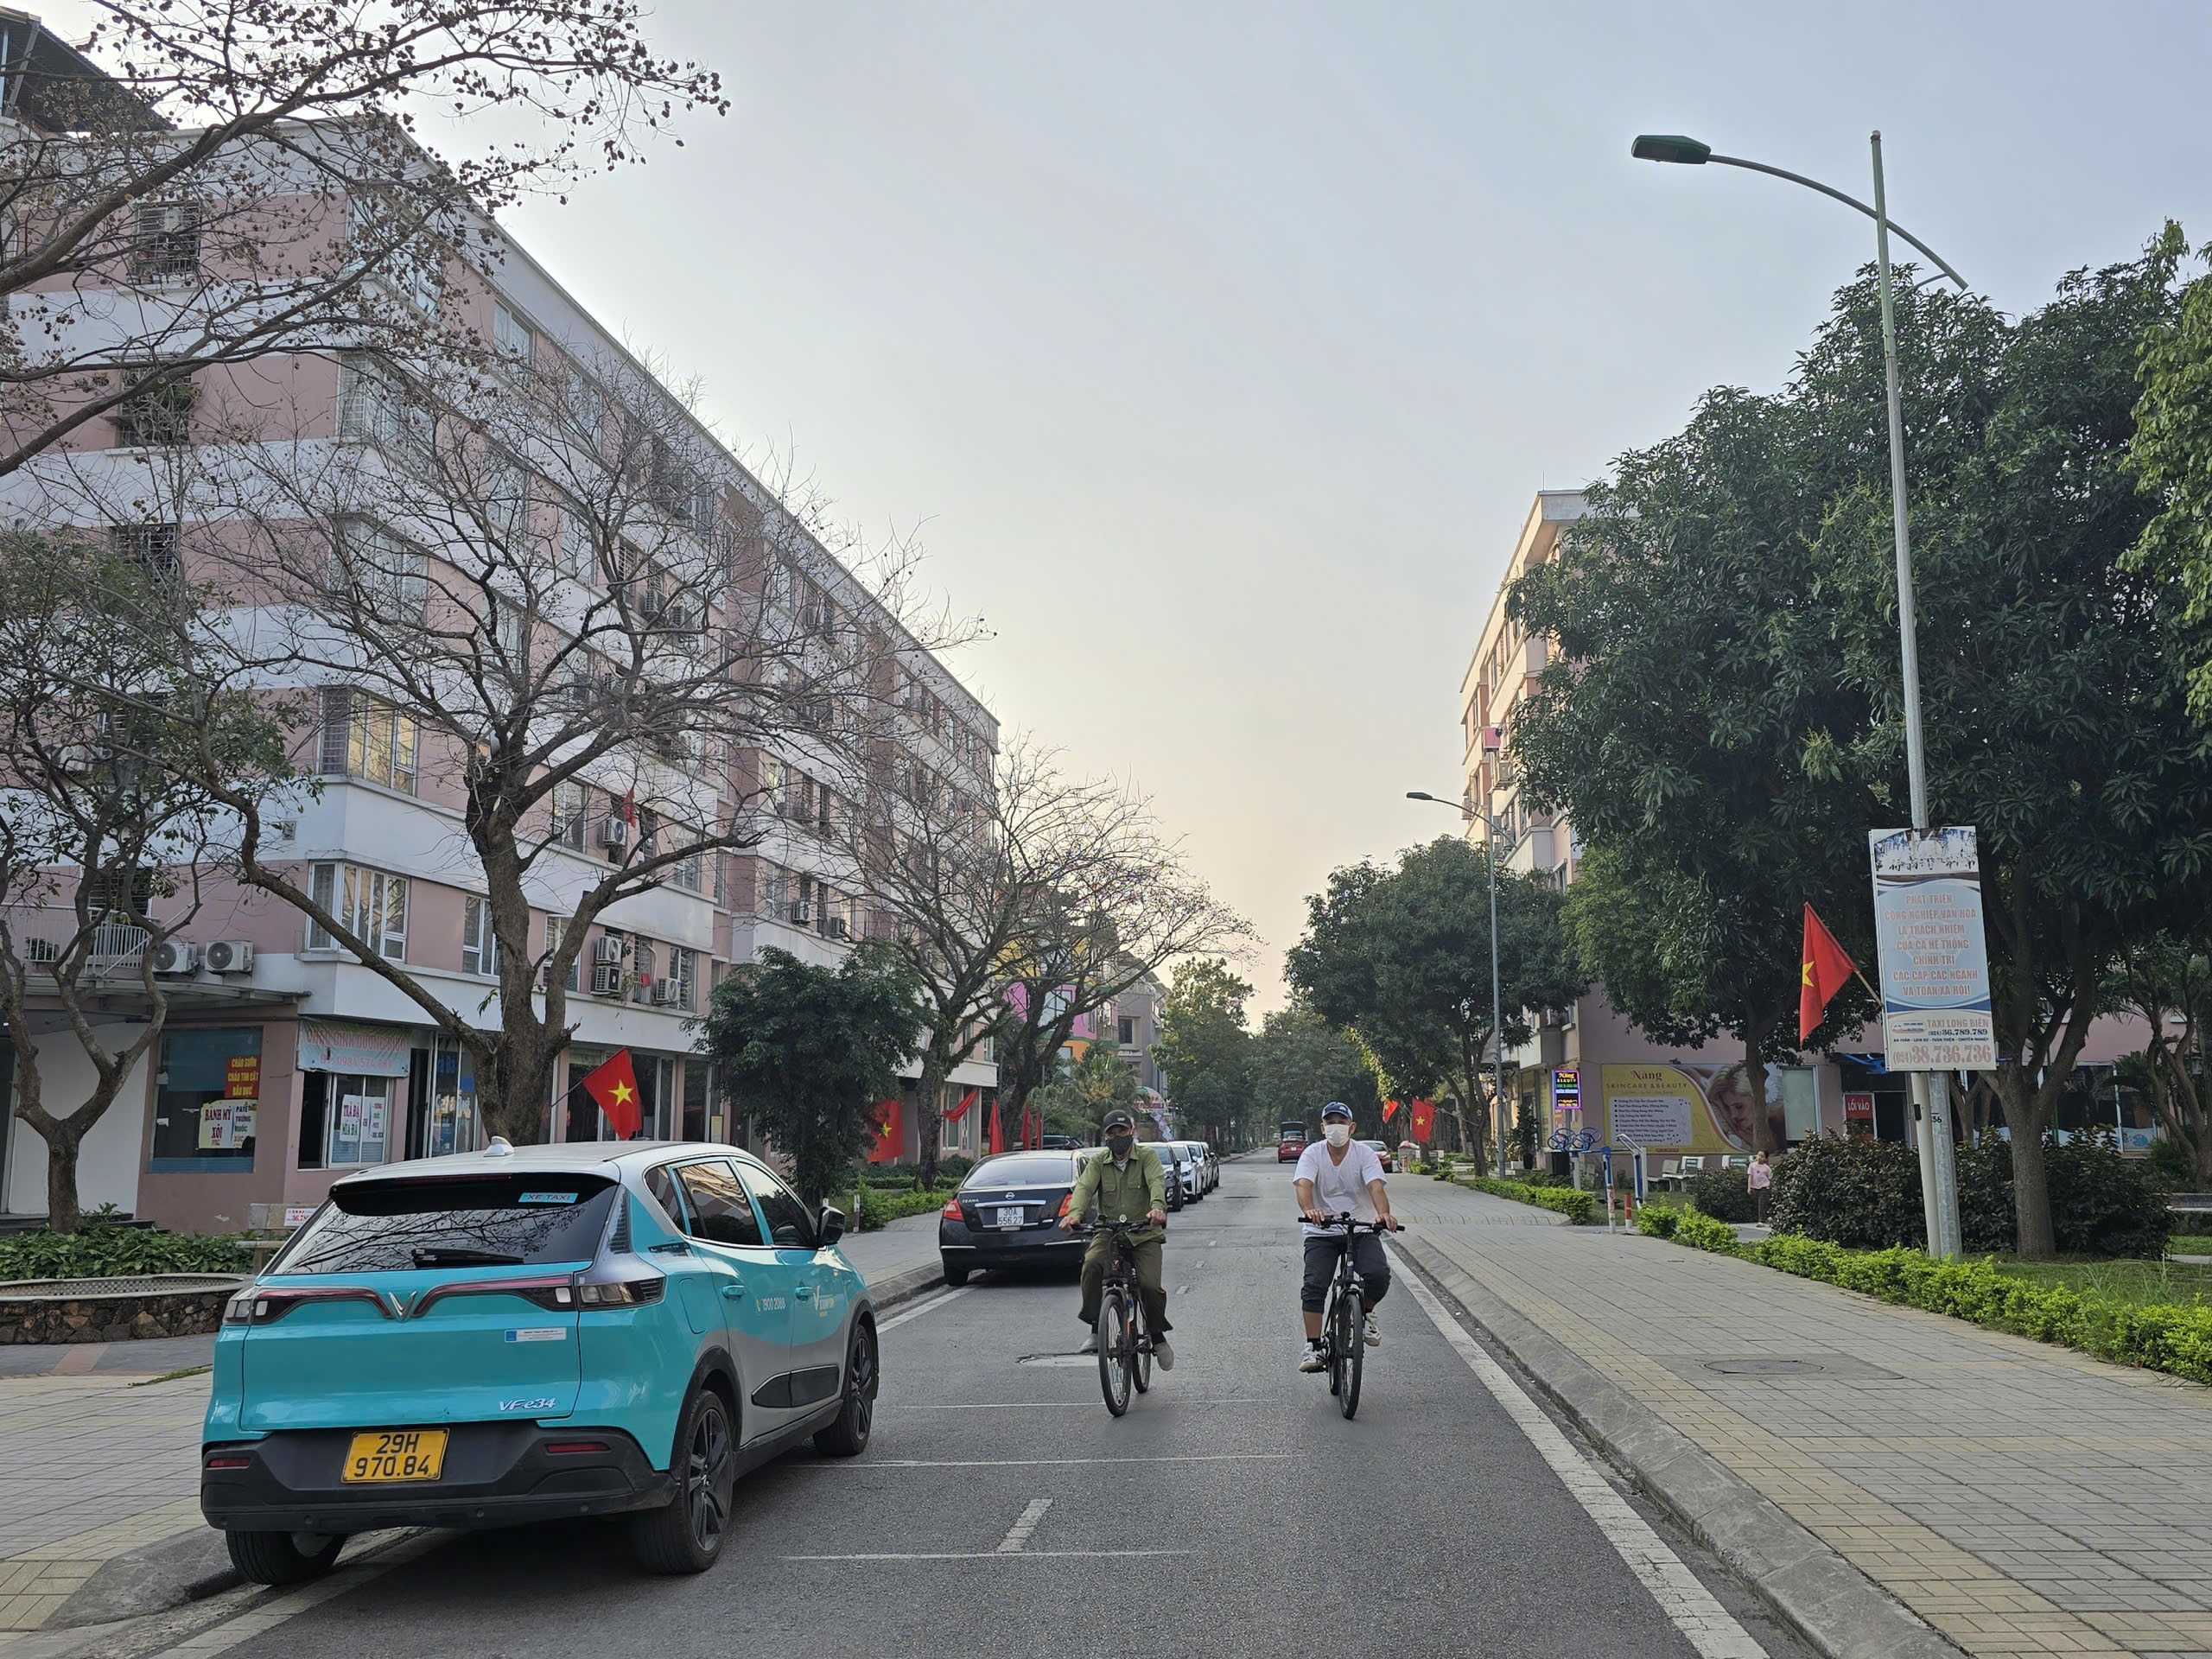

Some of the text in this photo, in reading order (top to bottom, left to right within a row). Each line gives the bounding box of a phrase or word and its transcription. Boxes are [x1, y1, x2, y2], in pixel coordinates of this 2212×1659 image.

[1928, 1020, 1945, 1028] TAXI
[1947, 1019, 1968, 1027] LONG
[1003, 1208, 1018, 1217] 30A
[376, 1433, 421, 1455] 29H
[353, 1453, 431, 1478] 970.84
